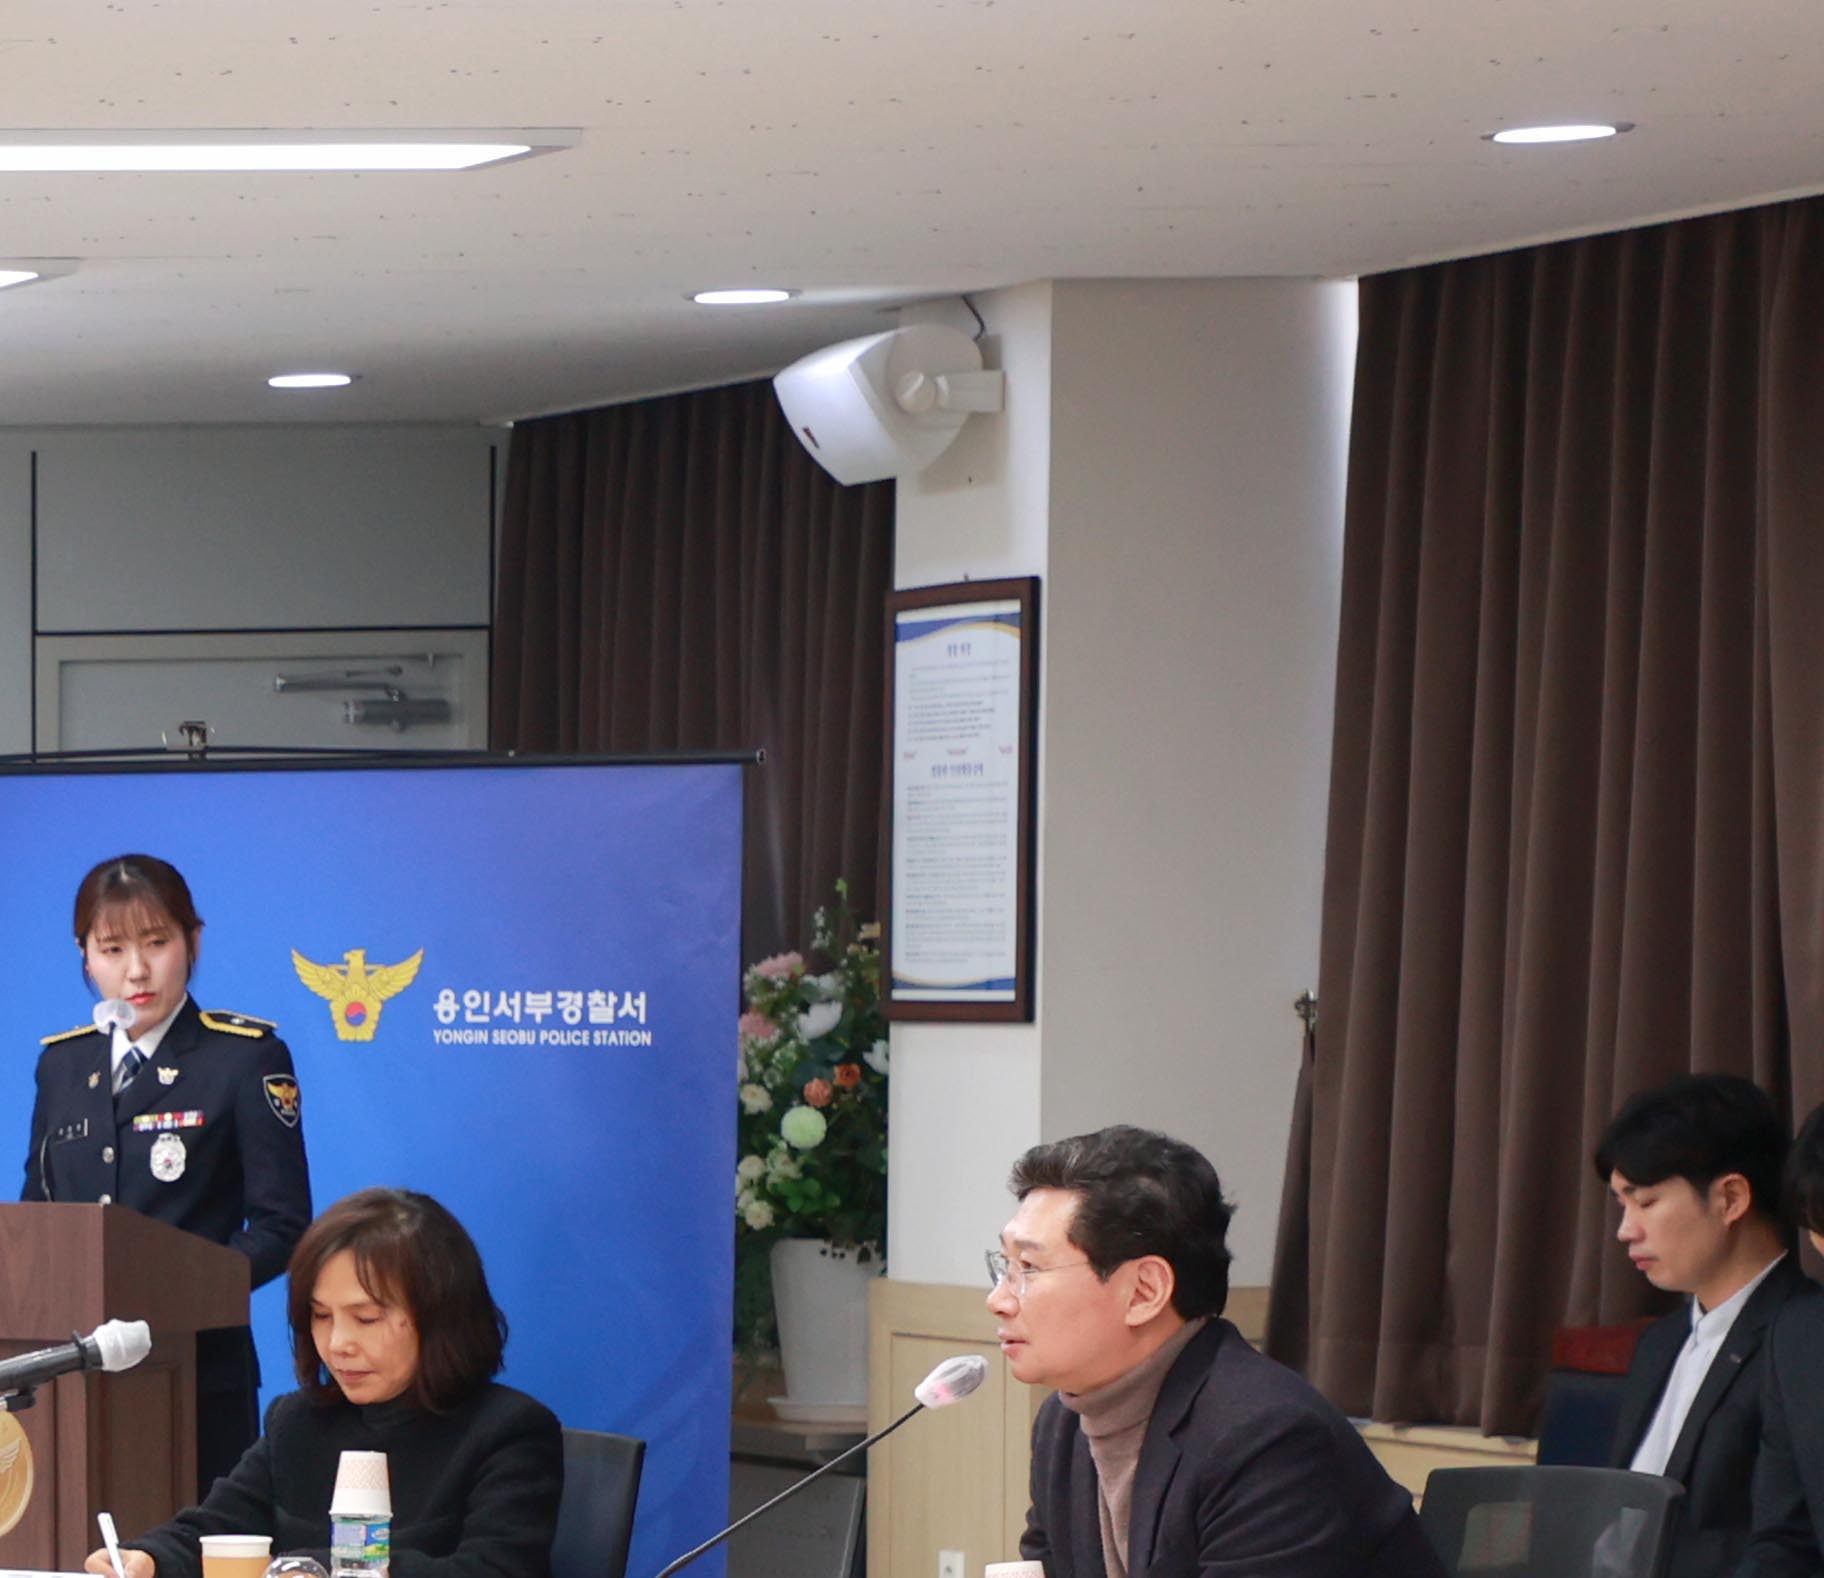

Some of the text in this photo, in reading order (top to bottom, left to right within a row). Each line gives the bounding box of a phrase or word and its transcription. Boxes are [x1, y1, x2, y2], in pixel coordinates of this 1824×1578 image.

[433, 988, 647, 1025] 용인서부경찰서
[433, 1029, 652, 1047] YONGIN SEOBU POLICE STATION
